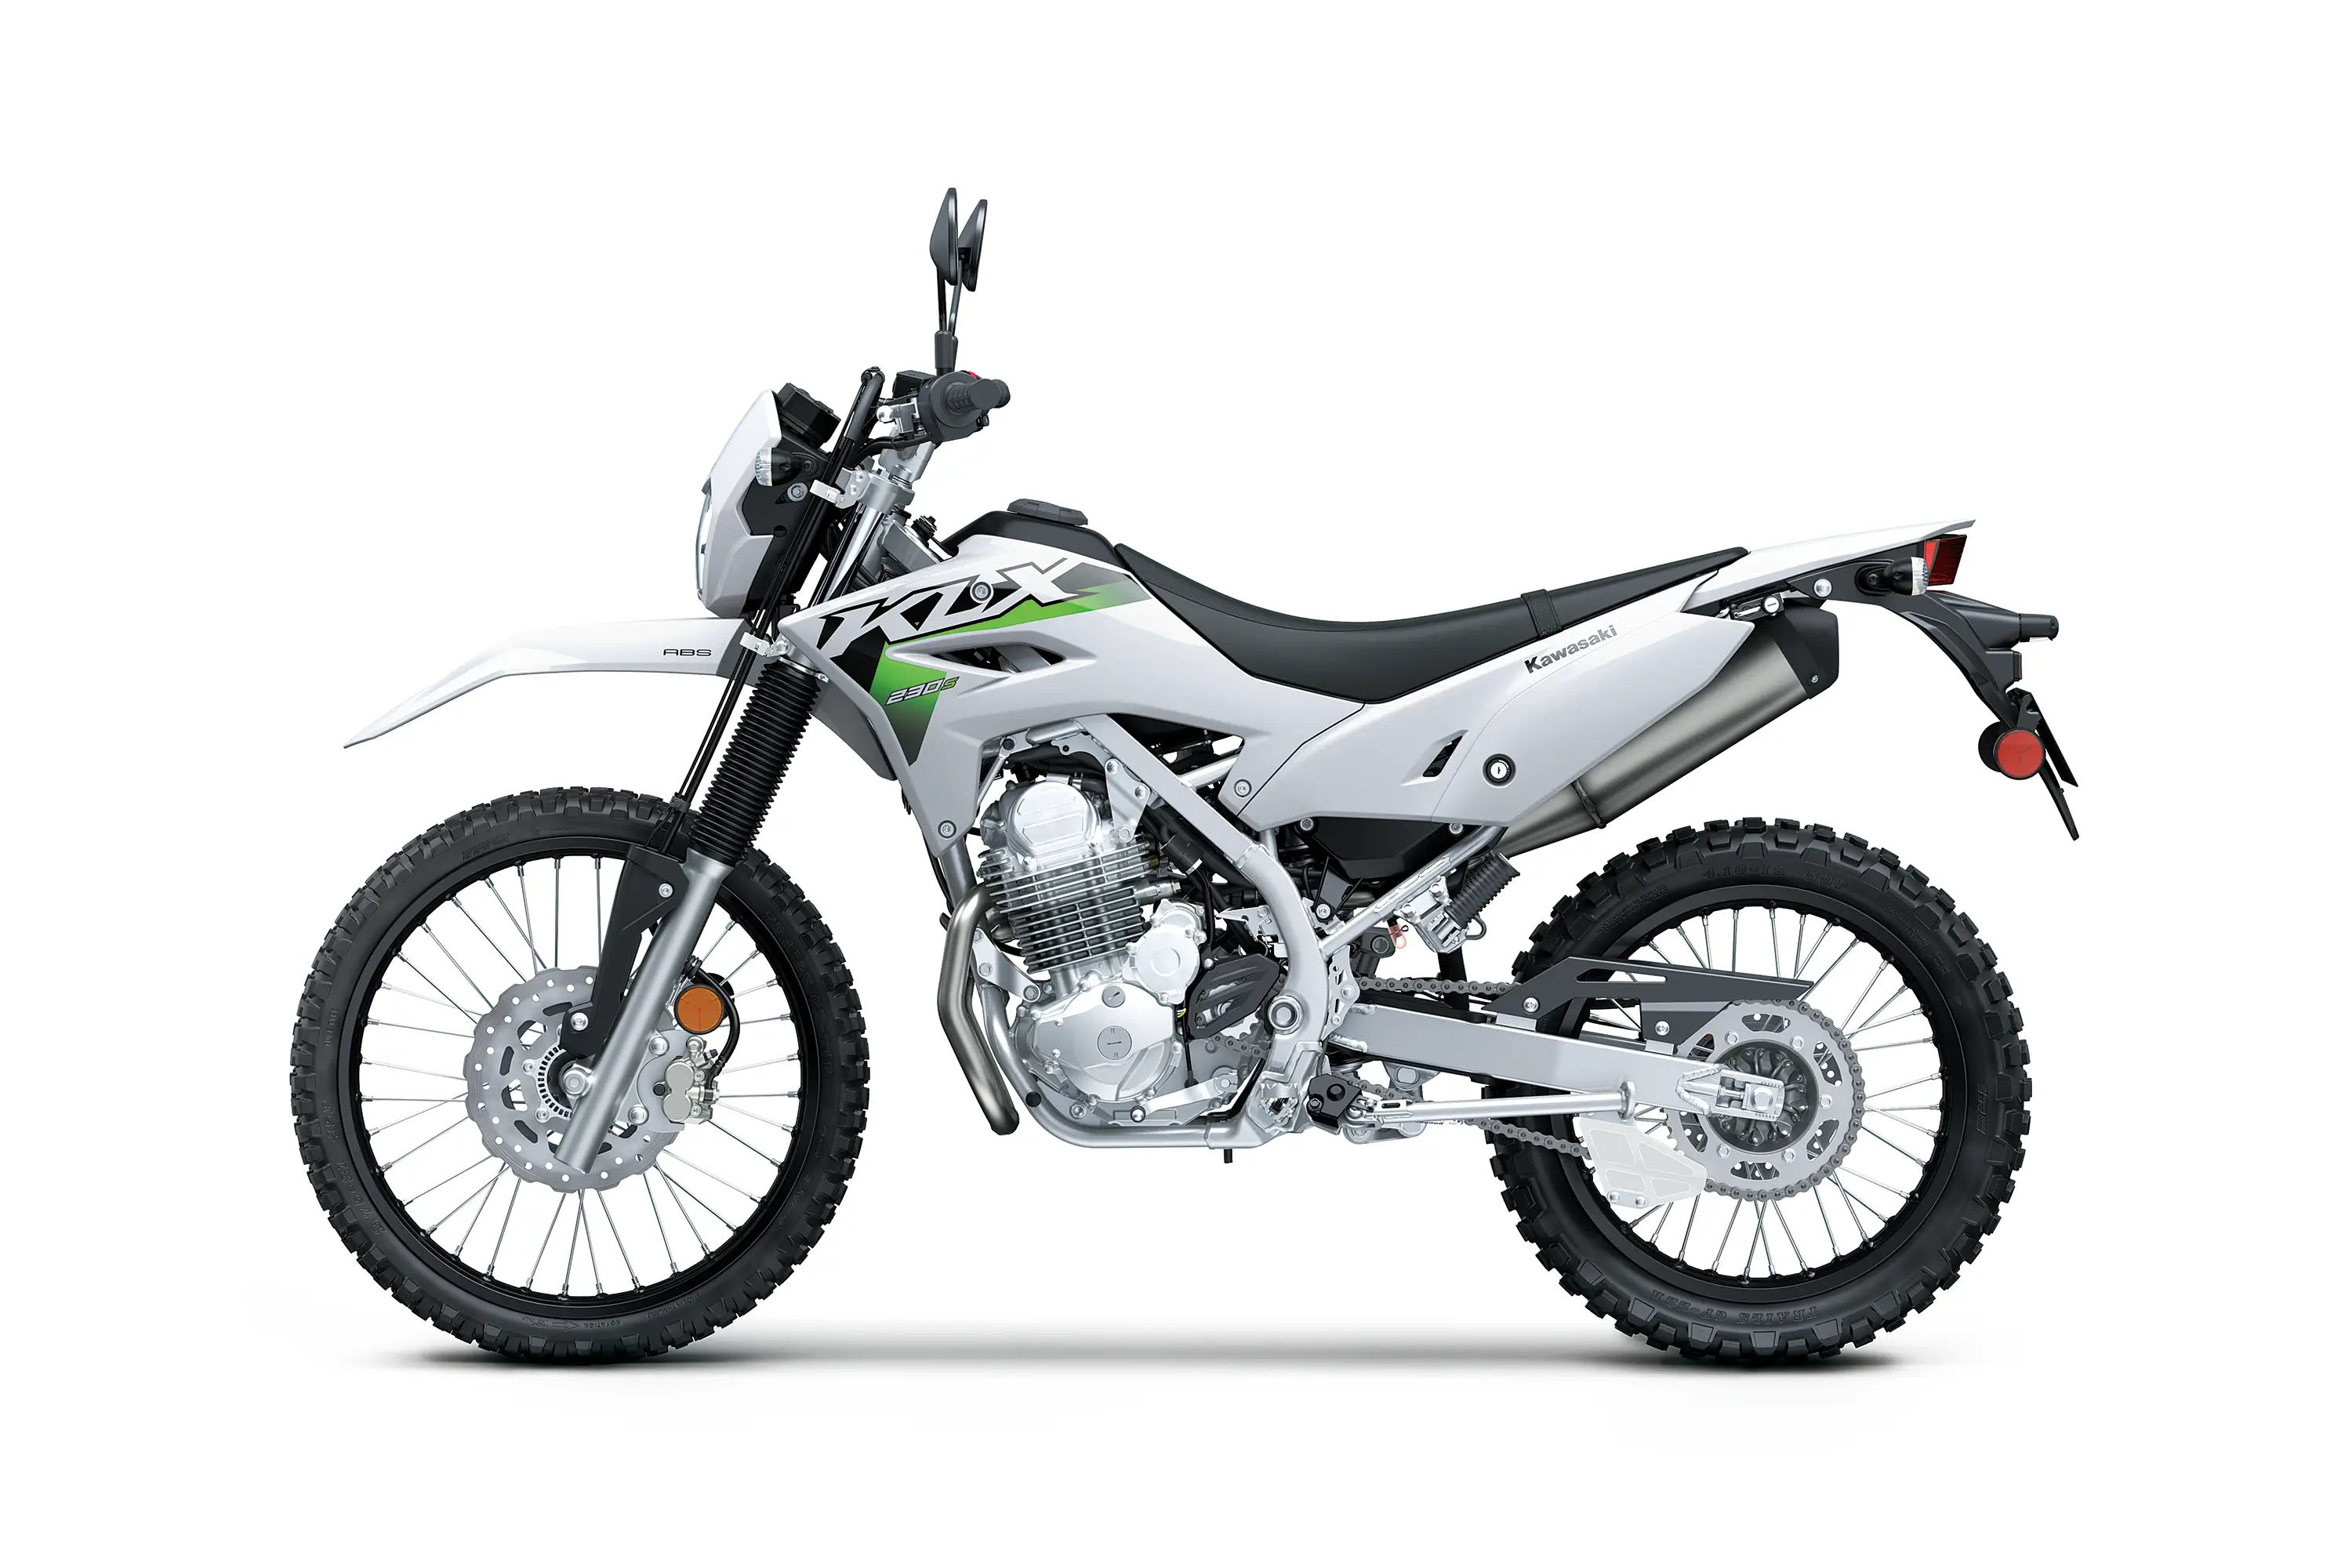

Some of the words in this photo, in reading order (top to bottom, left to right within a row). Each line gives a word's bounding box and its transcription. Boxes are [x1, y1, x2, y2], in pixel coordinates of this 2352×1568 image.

[1524, 625, 1617, 673] Kawasaki
[584, 1318, 622, 1328] ROTATION
[1736, 1305, 1820, 1325] TRAILS
